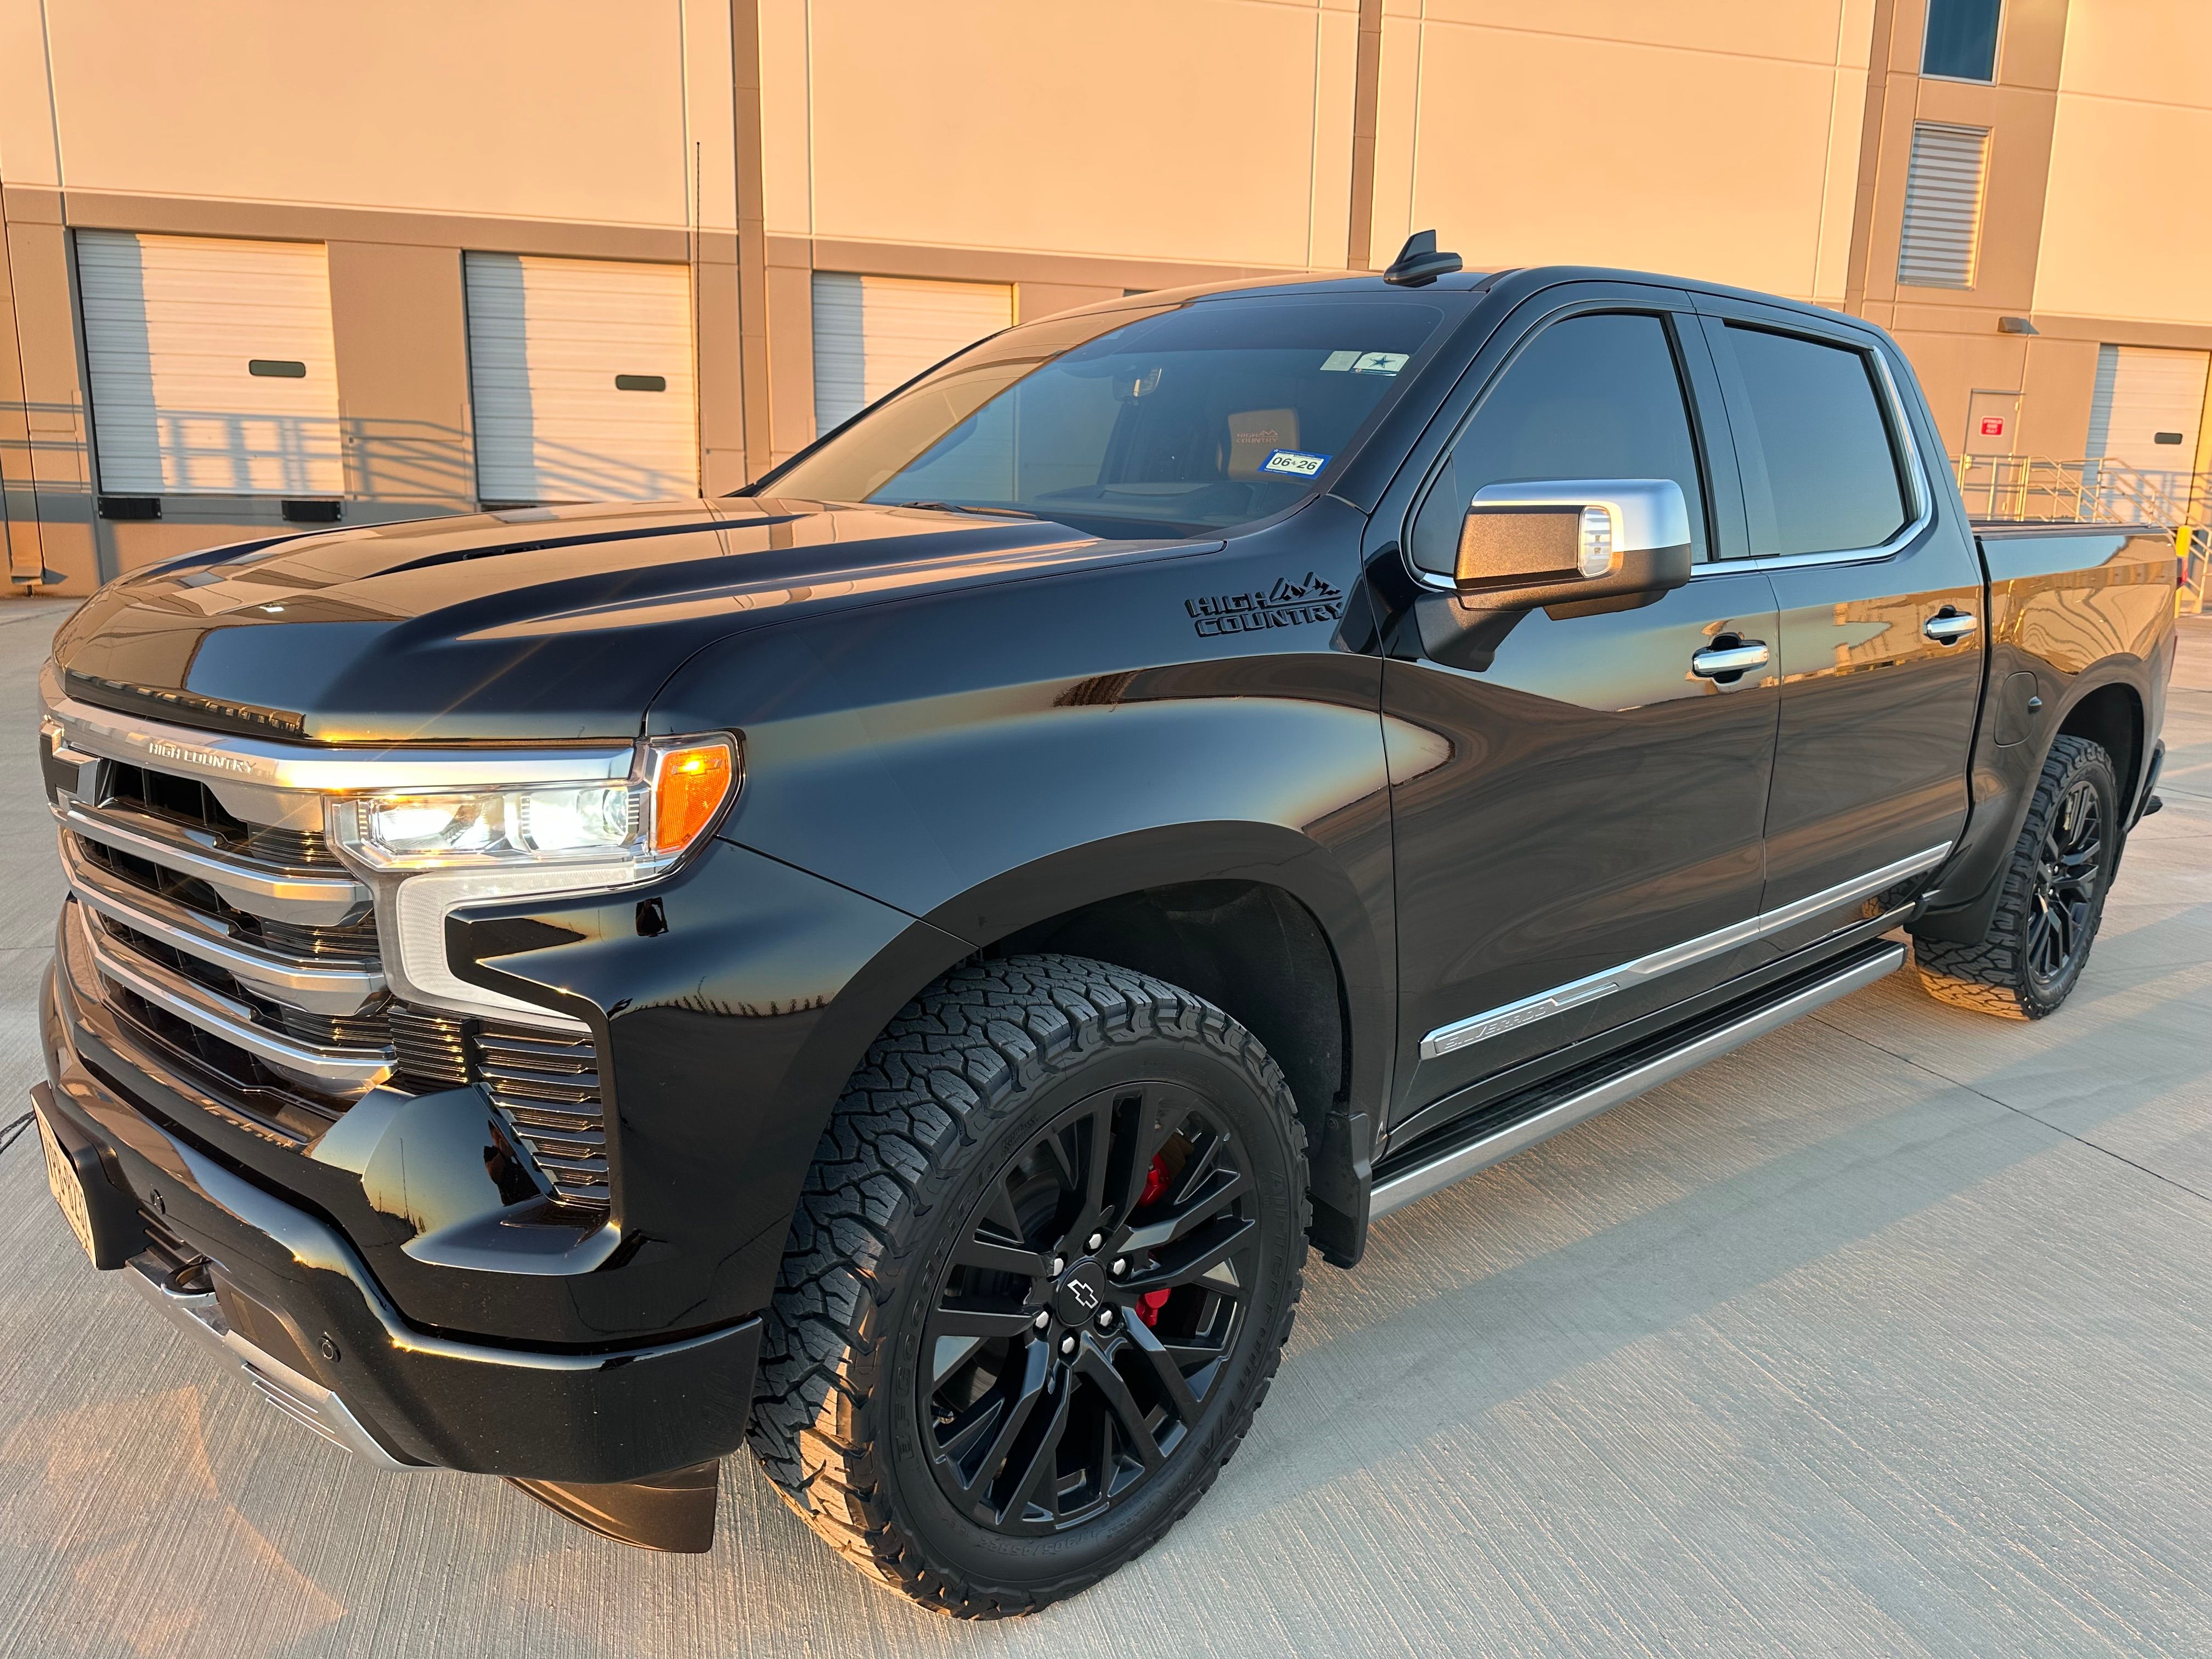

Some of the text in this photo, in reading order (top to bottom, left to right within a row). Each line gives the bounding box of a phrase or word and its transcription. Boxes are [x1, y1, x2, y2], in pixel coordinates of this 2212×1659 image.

[1184, 591, 1271, 618] HIGH
[1194, 602, 1344, 637] COUNTRY
[149, 742, 257, 774] HIGH COUNTRY
[1444, 1006, 1546, 1050] SILVERADO
[895, 1160, 995, 1463] BFGoodrich
